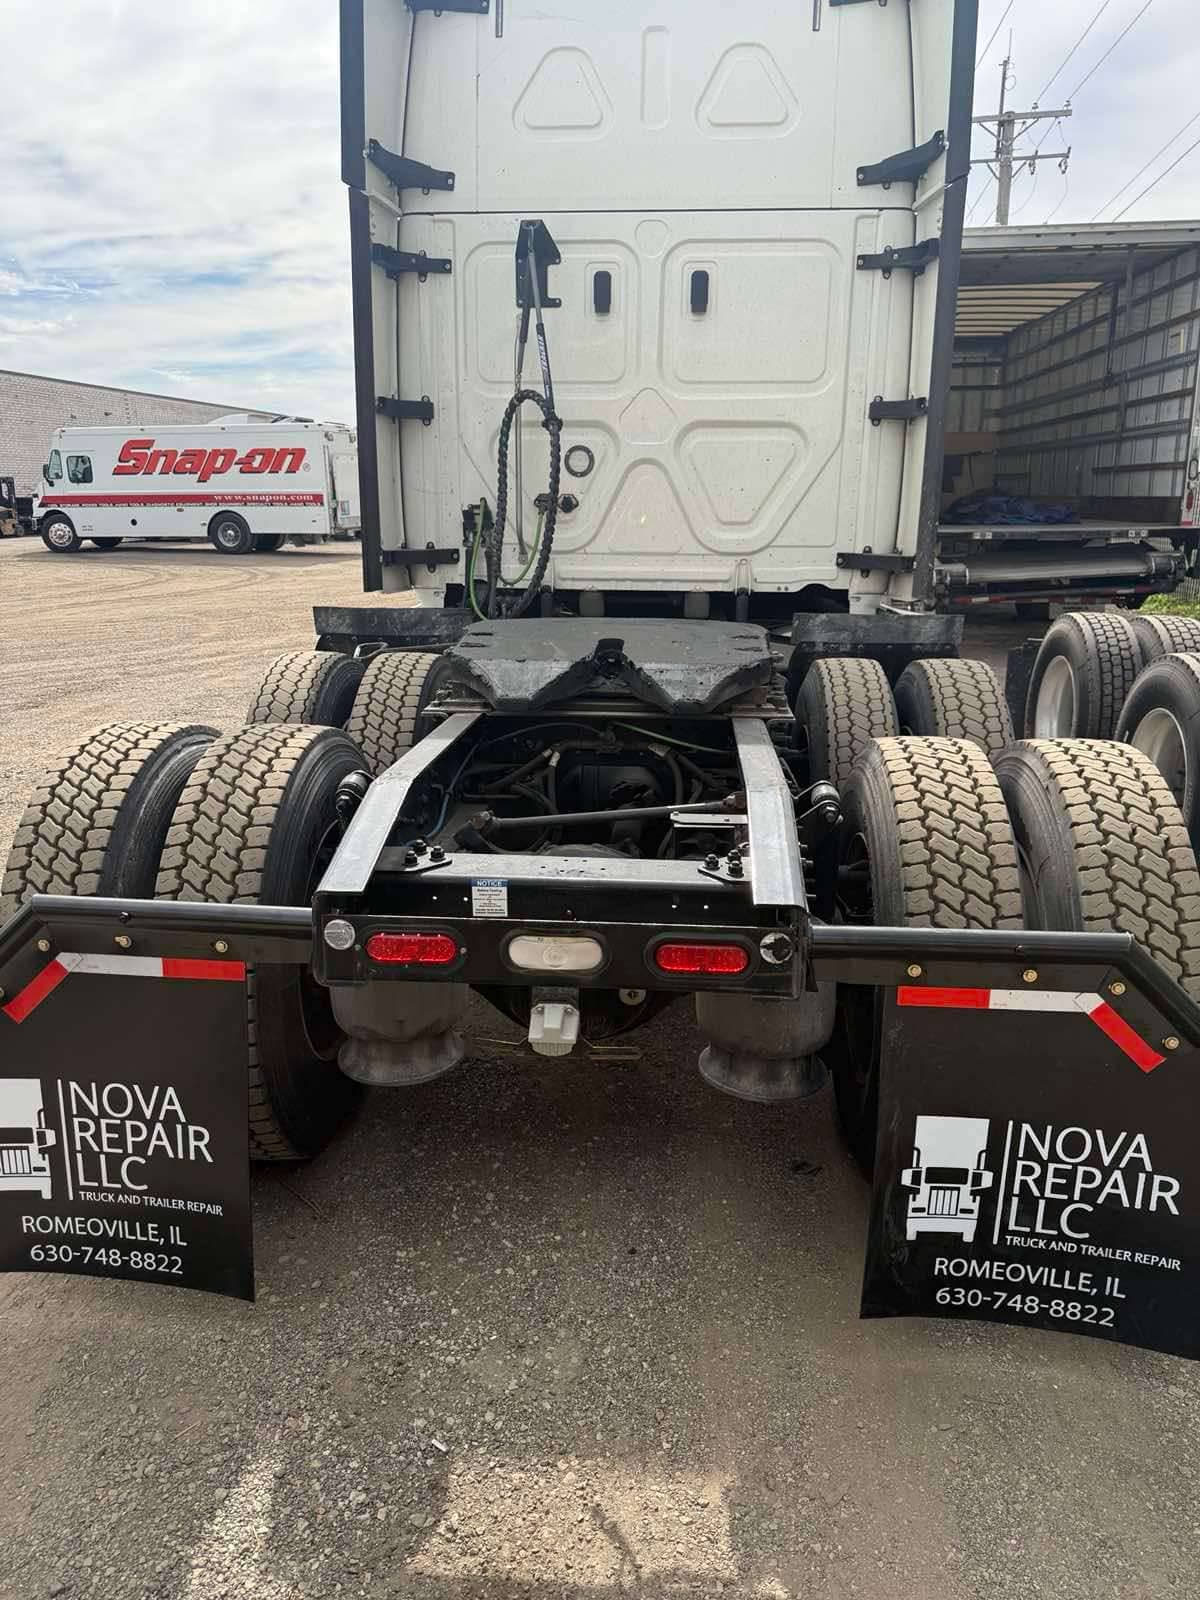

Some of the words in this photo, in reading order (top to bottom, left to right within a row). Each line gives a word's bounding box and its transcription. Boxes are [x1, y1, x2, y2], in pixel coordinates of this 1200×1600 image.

[112, 439, 306, 482] Snap-on
[214, 494, 314, 502] www.snapon.com
[69, 1080, 187, 1123] NOVA
[72, 1117, 214, 1163] REPAIR
[1017, 1122, 1153, 1172] NOVA
[75, 1152, 149, 1191] LLC
[1012, 1159, 1180, 1215] REPAIR
[78, 1191, 115, 1203] TRUCK
[117, 1194, 141, 1206] AND
[143, 1195, 186, 1210] TRAILER
[187, 1201, 223, 1217] REPAIR
[1007, 1196, 1094, 1239] LLC
[21, 1215, 165, 1246] ROMEOVILLE,
[169, 1225, 188, 1247] IL
[30, 1244, 184, 1275] 630-748-8822
[1005, 1235, 1048, 1250] TRUCK
[1049, 1240, 1078, 1254] AND
[1080, 1244, 1132, 1263] TRAILER
[1134, 1252, 1181, 1271] REPAIR
[933, 1257, 1098, 1297] ROMEOVILLE,
[1105, 1276, 1127, 1299] IL
[935, 1287, 1115, 1328] 630-748-8822
